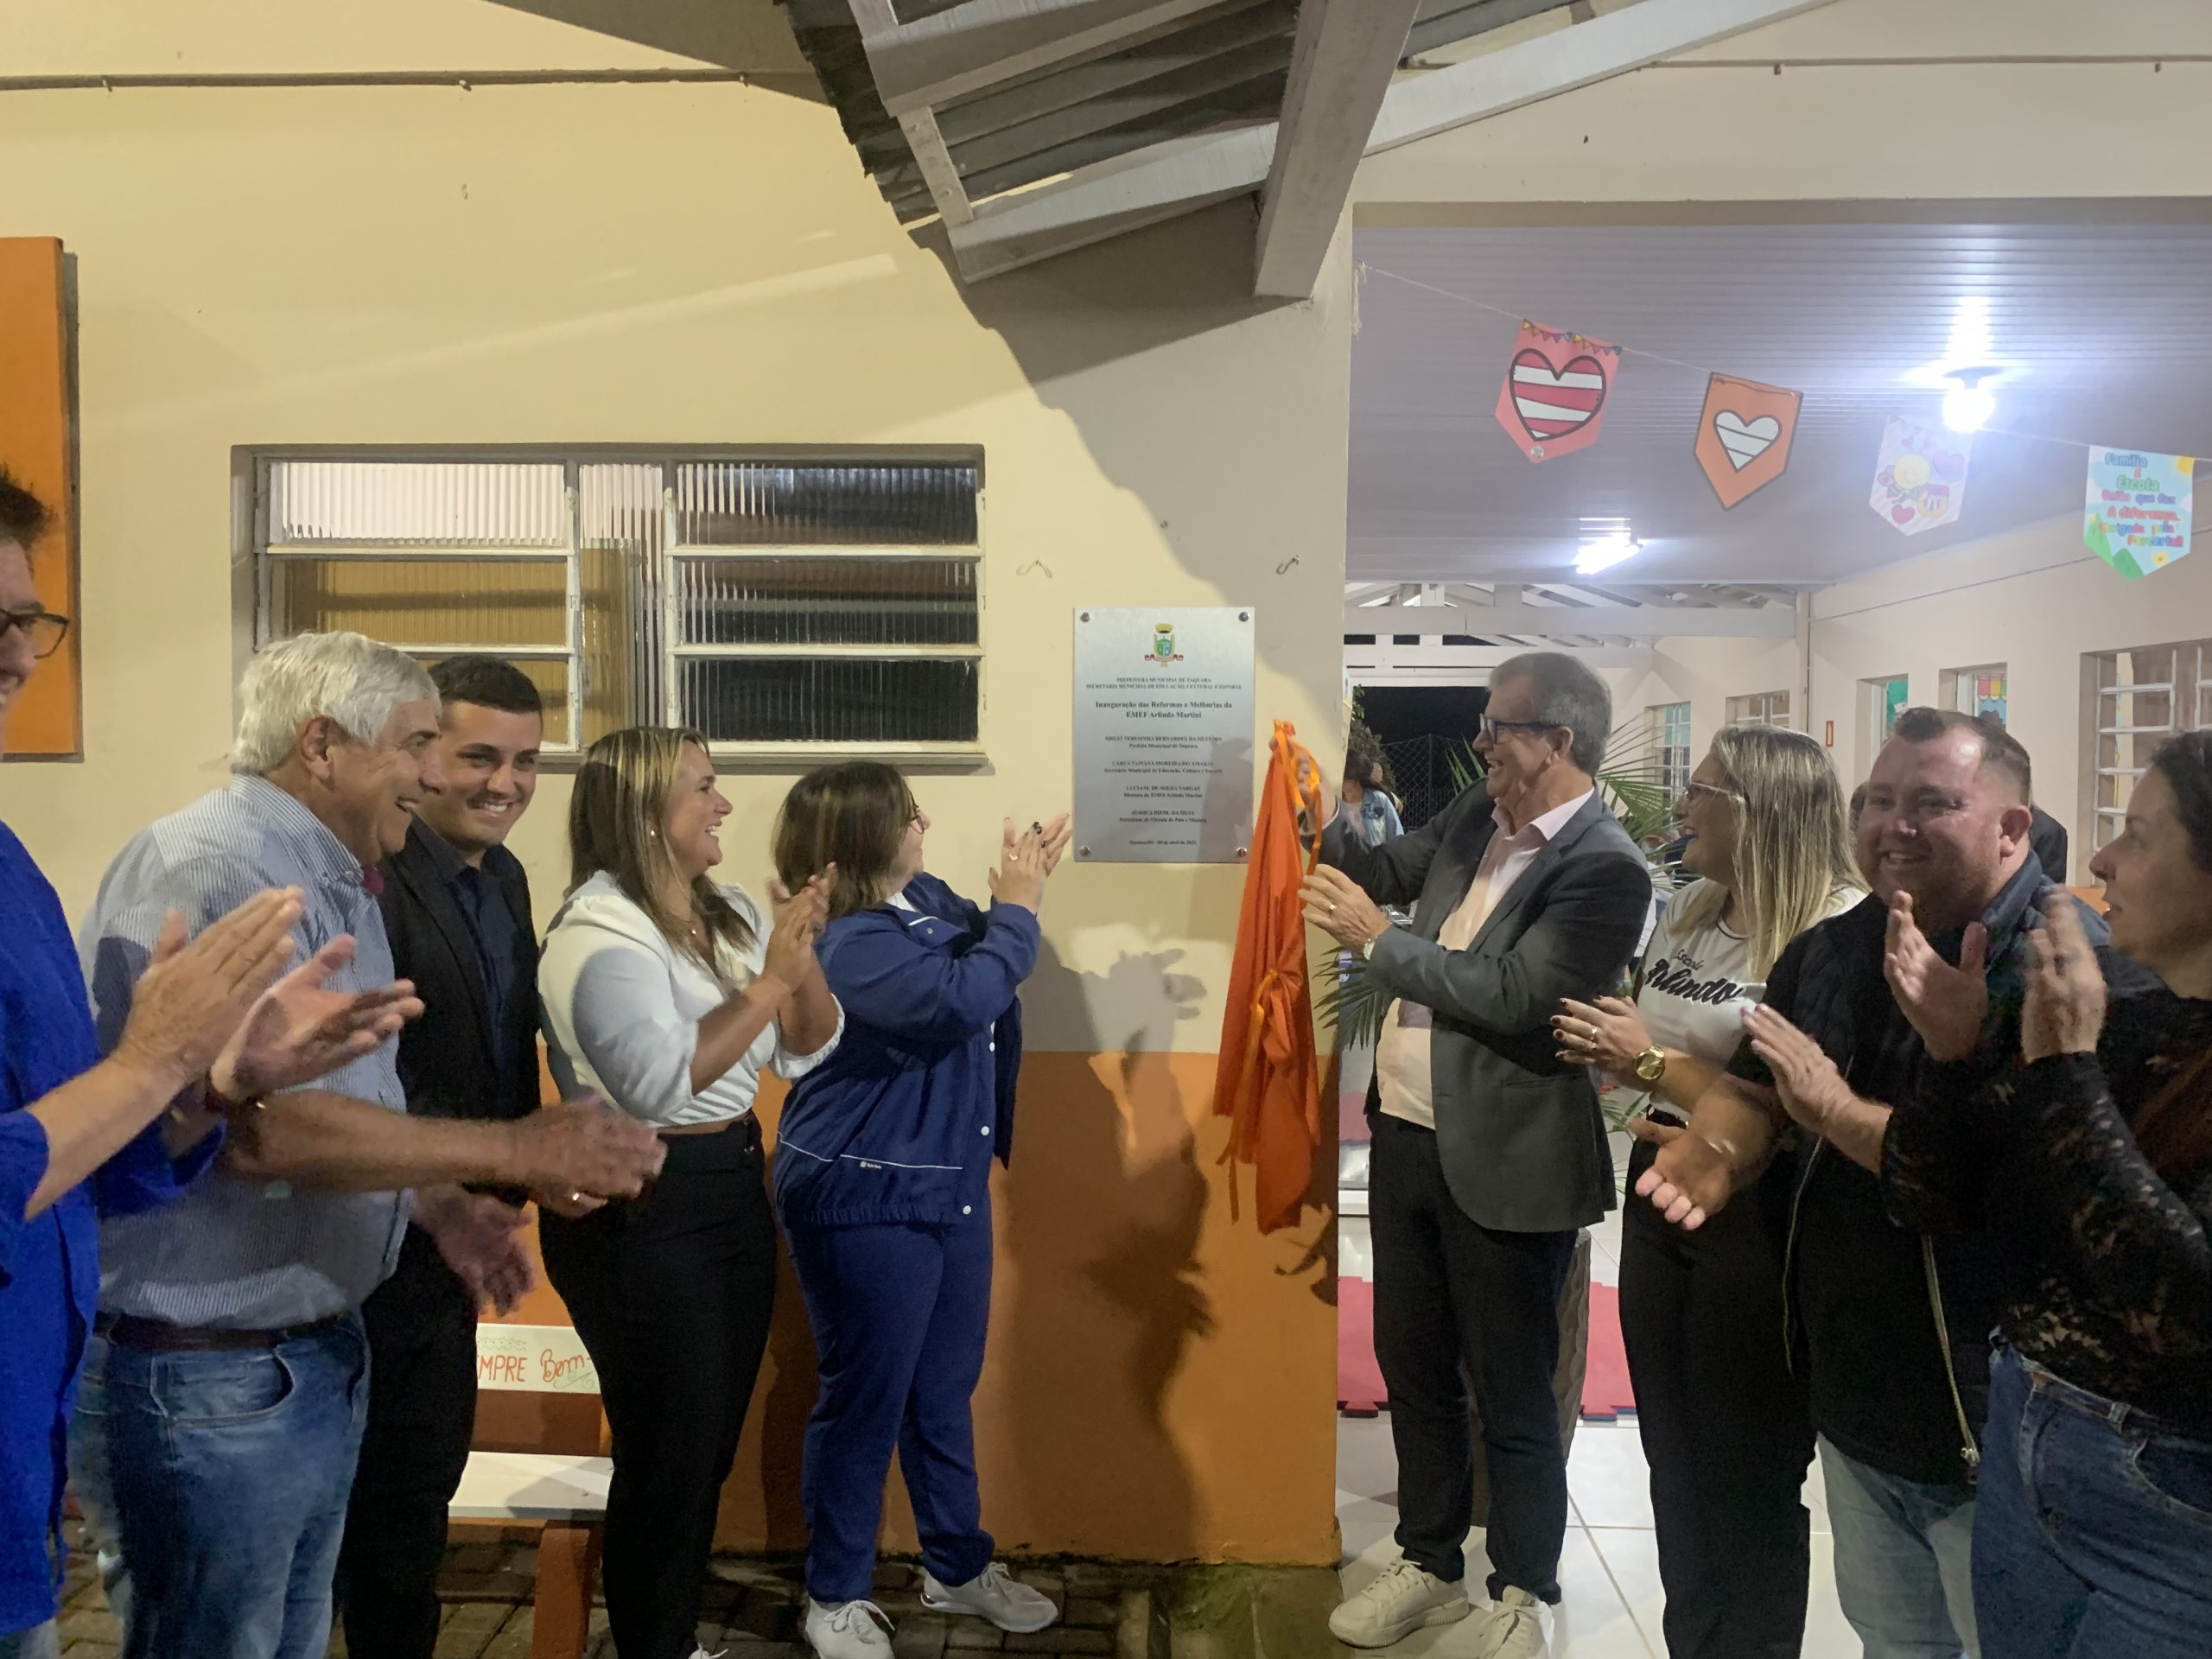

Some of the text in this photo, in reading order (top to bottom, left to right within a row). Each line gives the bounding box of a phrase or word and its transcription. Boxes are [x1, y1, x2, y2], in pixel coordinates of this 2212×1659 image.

[2116, 474, 2160, 493] Escola
[1096, 701, 1137, 709] Inauguração
[477, 1354, 528, 1382] MPRE
